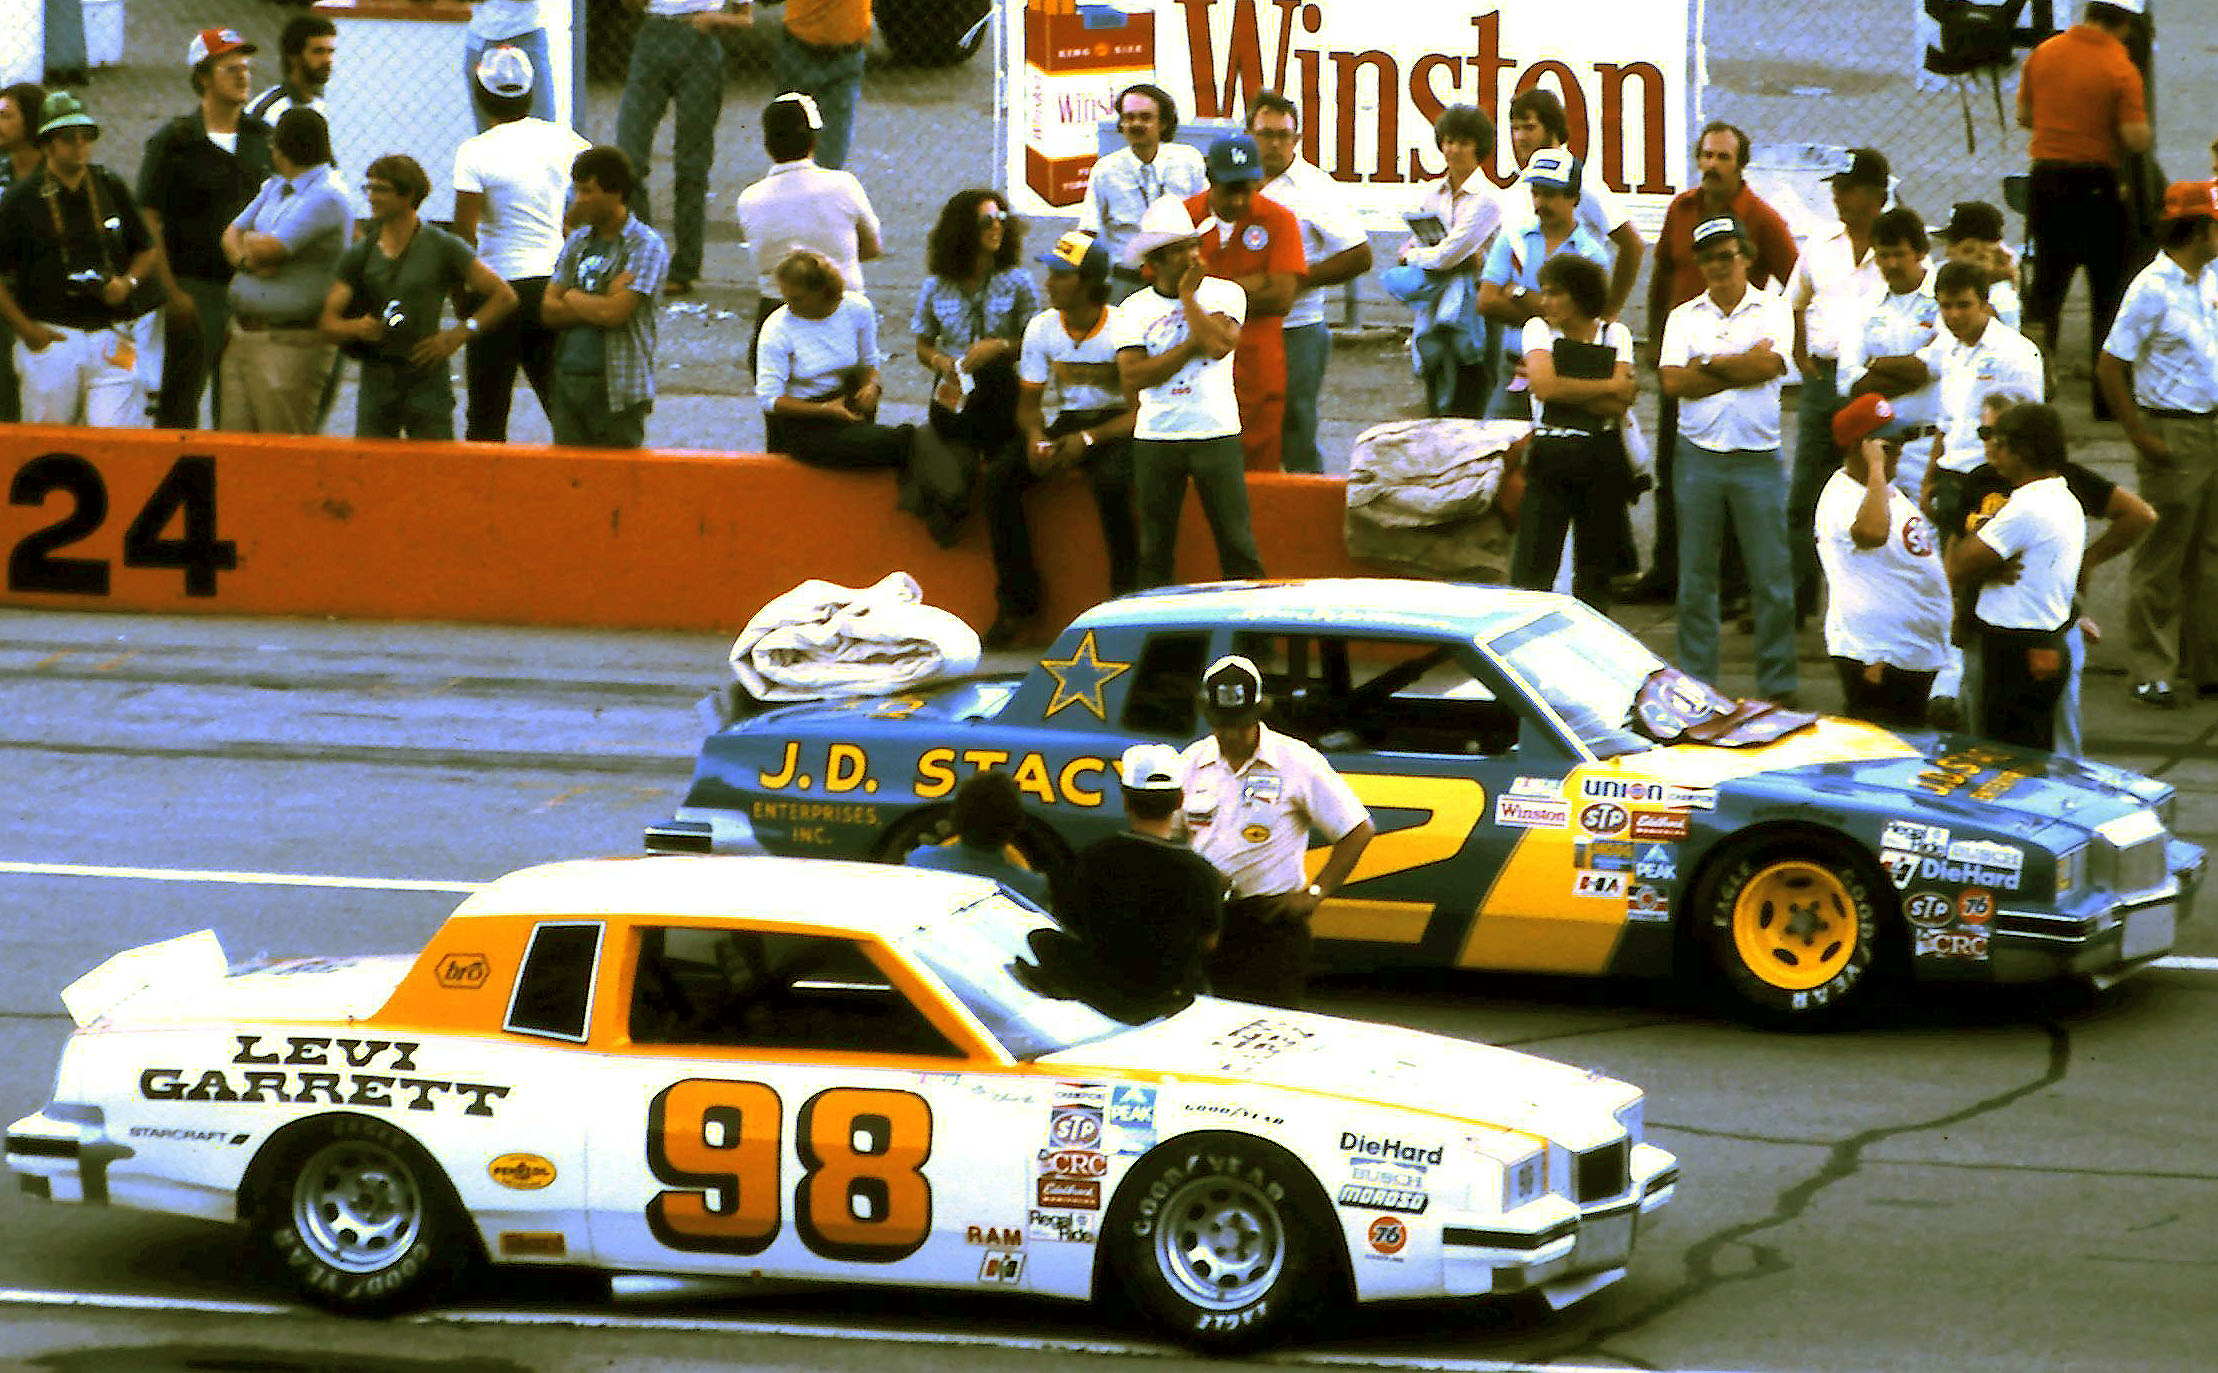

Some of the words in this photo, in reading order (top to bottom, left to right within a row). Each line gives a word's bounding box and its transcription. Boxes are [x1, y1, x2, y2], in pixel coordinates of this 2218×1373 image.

[1173, 0, 1675, 194] Winston
[8, 452, 237, 597] 24
[759, 740, 812, 790] J.
[825, 742, 880, 793] D.
[913, 747, 1124, 807] STAC
[1501, 803, 1566, 822] Winston
[1584, 803, 1622, 831] STP
[791, 826, 832, 844] INC.
[1304, 770, 1487, 945] 2
[1635, 862, 1677, 879] PEAK
[1920, 857, 2022, 890] DieHard
[1910, 895, 1949, 918] STP
[1964, 894, 1990, 916] 76
[1936, 934, 1990, 954] CRC
[232, 1035, 421, 1071] LEVI
[138, 1067, 512, 1117] GARRETT
[1109, 1104, 1153, 1122] PEAK
[130, 1127, 228, 1142] STARCRAFT
[1056, 1115, 1096, 1141] STP
[1339, 1132, 1444, 1165] DieHard
[645, 1077, 934, 1264] 98
[1053, 1153, 1107, 1176] CRC
[1028, 1209, 1073, 1230] Regal
[967, 1225, 1022, 1245] RAM
[1059, 1228, 1092, 1243] Ride
[1376, 1225, 1400, 1244] 76
